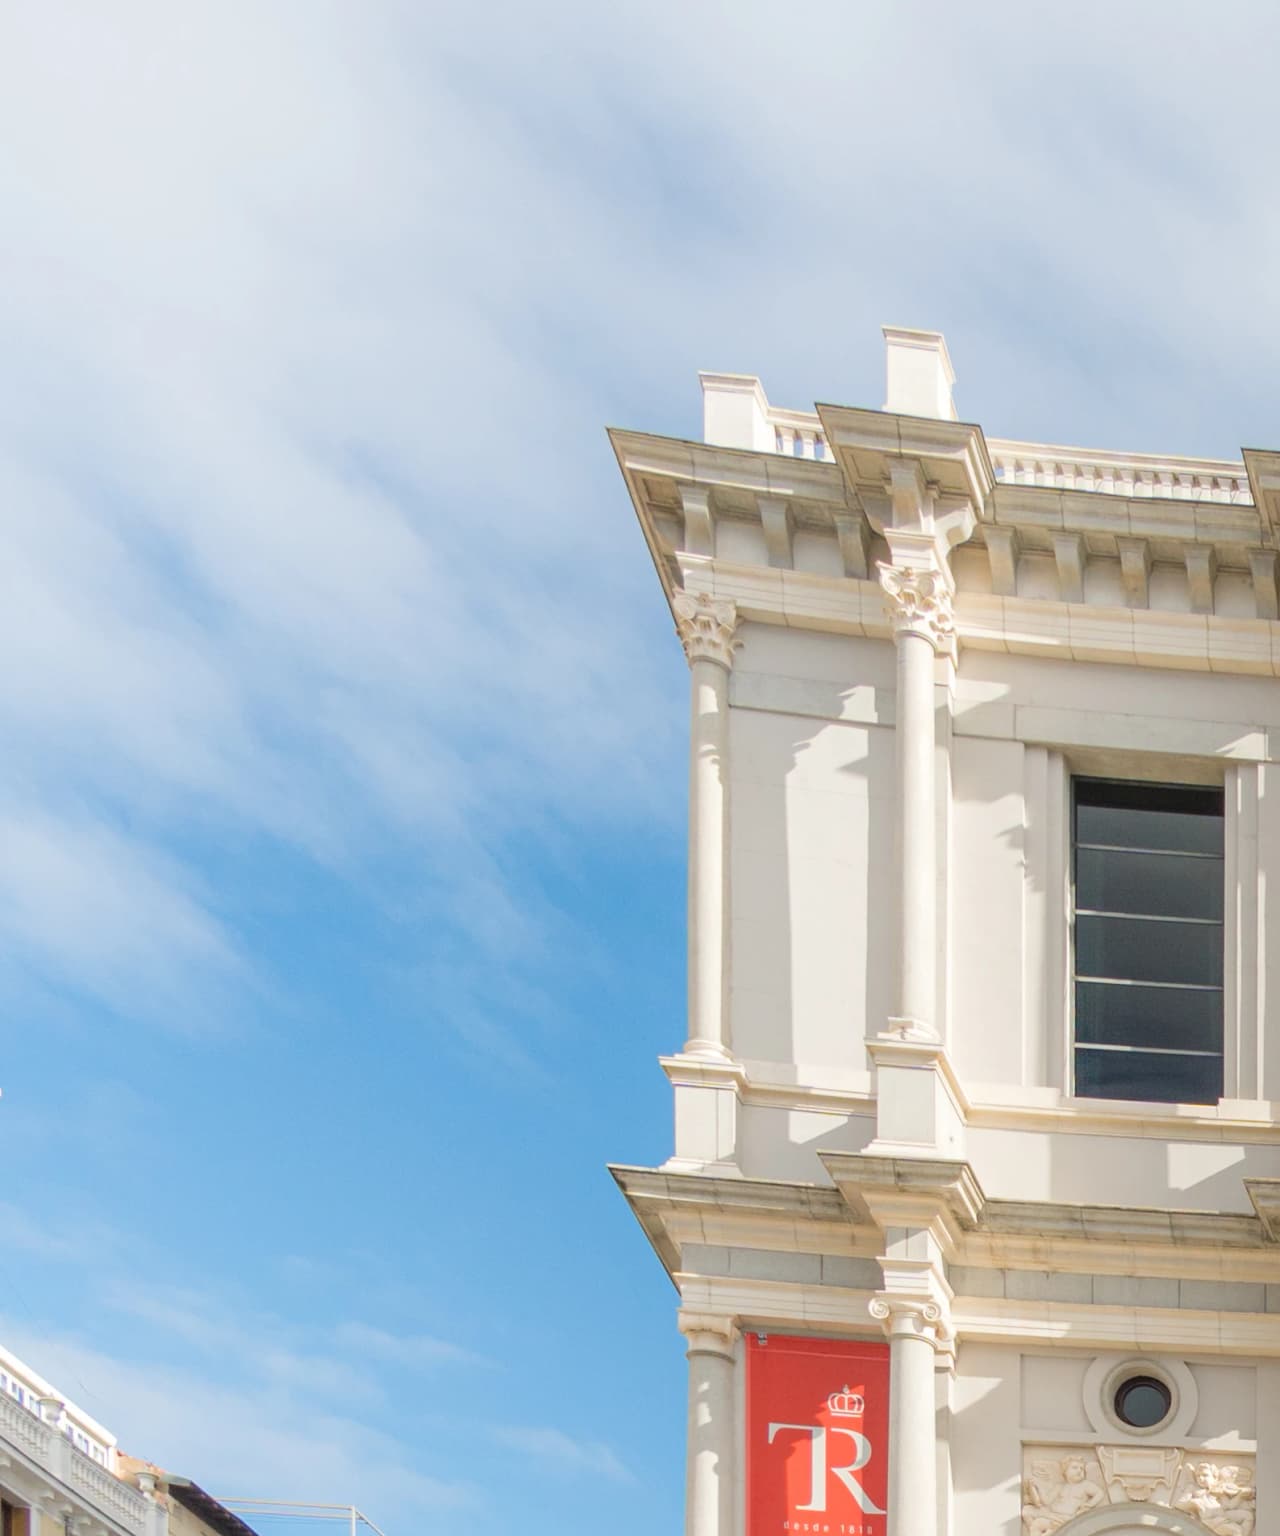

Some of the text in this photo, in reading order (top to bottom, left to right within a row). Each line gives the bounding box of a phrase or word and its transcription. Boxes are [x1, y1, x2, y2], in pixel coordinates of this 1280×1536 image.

[768, 1422, 887, 1514] TR
[783, 1521, 873, 1535] desde 1818
